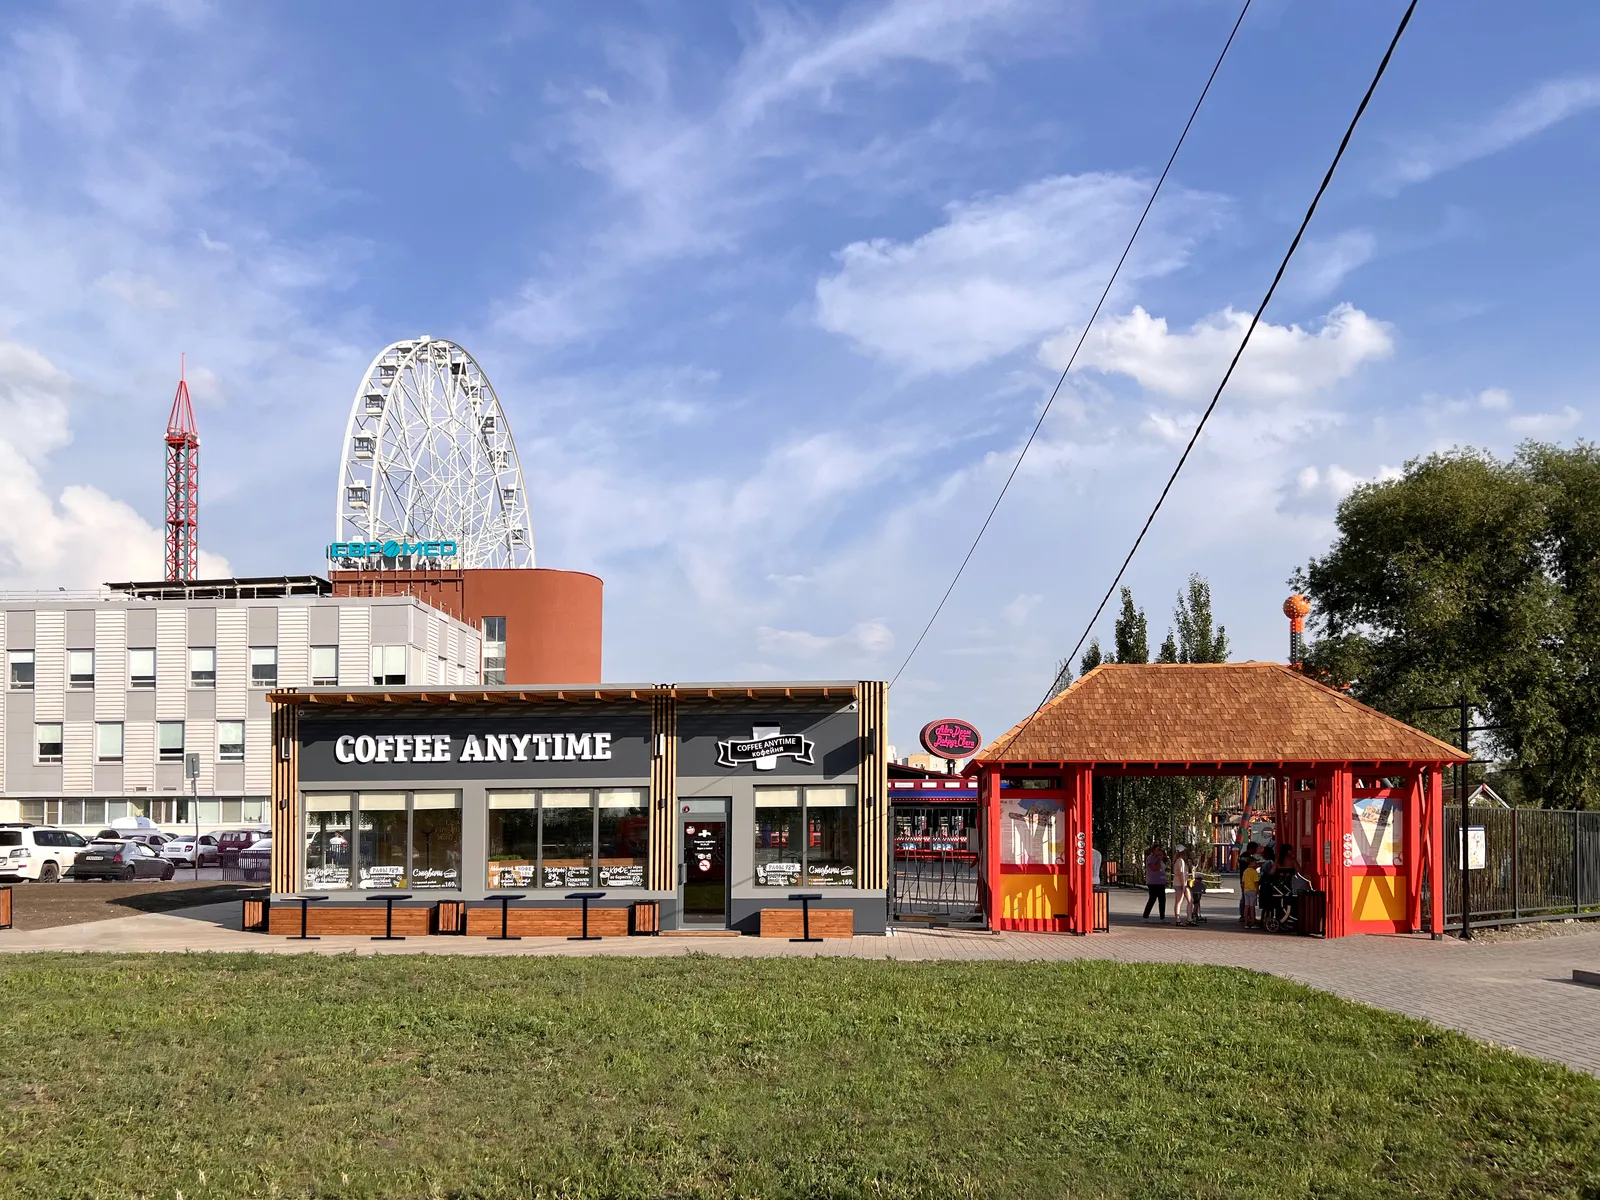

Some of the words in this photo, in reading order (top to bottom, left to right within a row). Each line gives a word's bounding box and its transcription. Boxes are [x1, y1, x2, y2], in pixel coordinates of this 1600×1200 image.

[335, 734, 451, 763] COFFEE
[459, 732, 612, 762] ANYTIME
[736, 742, 763, 752] COFFEE
[763, 737, 796, 748] ANYTIME
[751, 746, 784, 758] кофейня
[609, 866, 629, 874] КОФЕ
